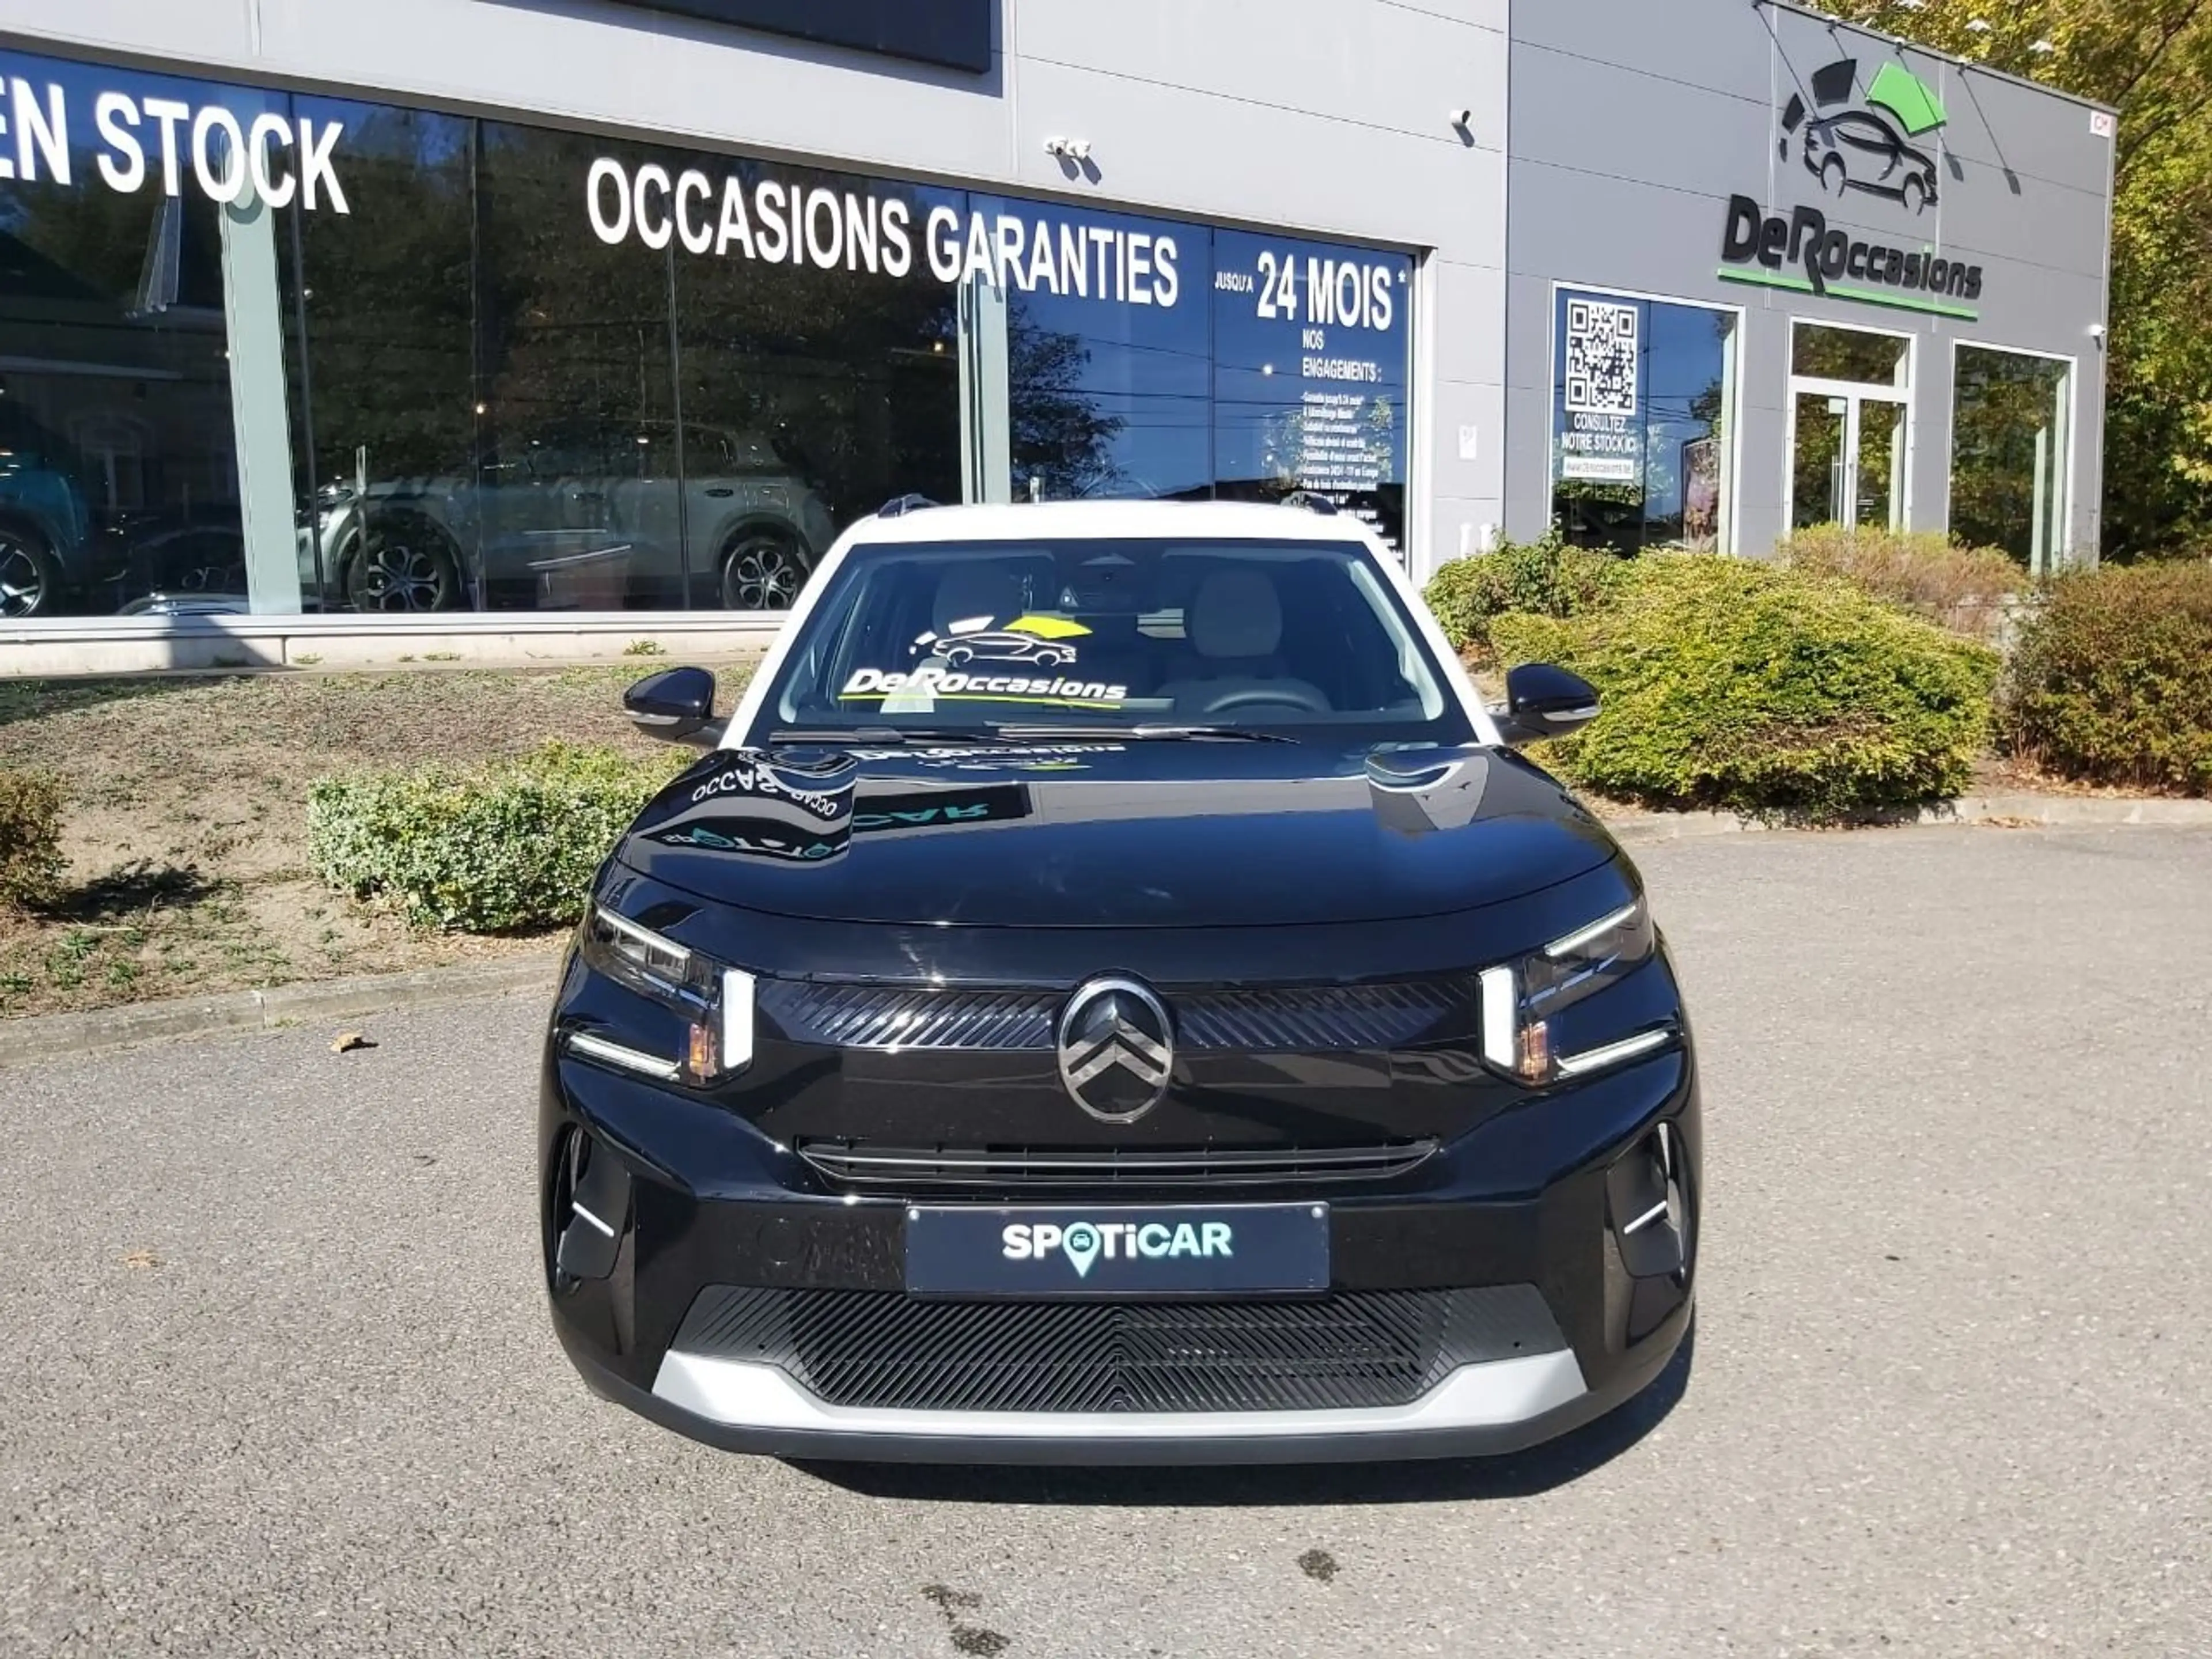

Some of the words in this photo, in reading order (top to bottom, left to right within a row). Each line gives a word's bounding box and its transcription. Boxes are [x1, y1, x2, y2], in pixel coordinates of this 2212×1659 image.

[95, 91, 350, 215] STOCK
[587, 157, 911, 277] OCCASIONS
[927, 204, 1178, 308] GARANTIES
[1257, 251, 1297, 320] 24
[1302, 329, 1324, 350] NOS
[1574, 412, 1626, 433] CONSULTEZ
[1562, 431, 1592, 450] NOTRE
[1594, 434, 1624, 453] STOCK
